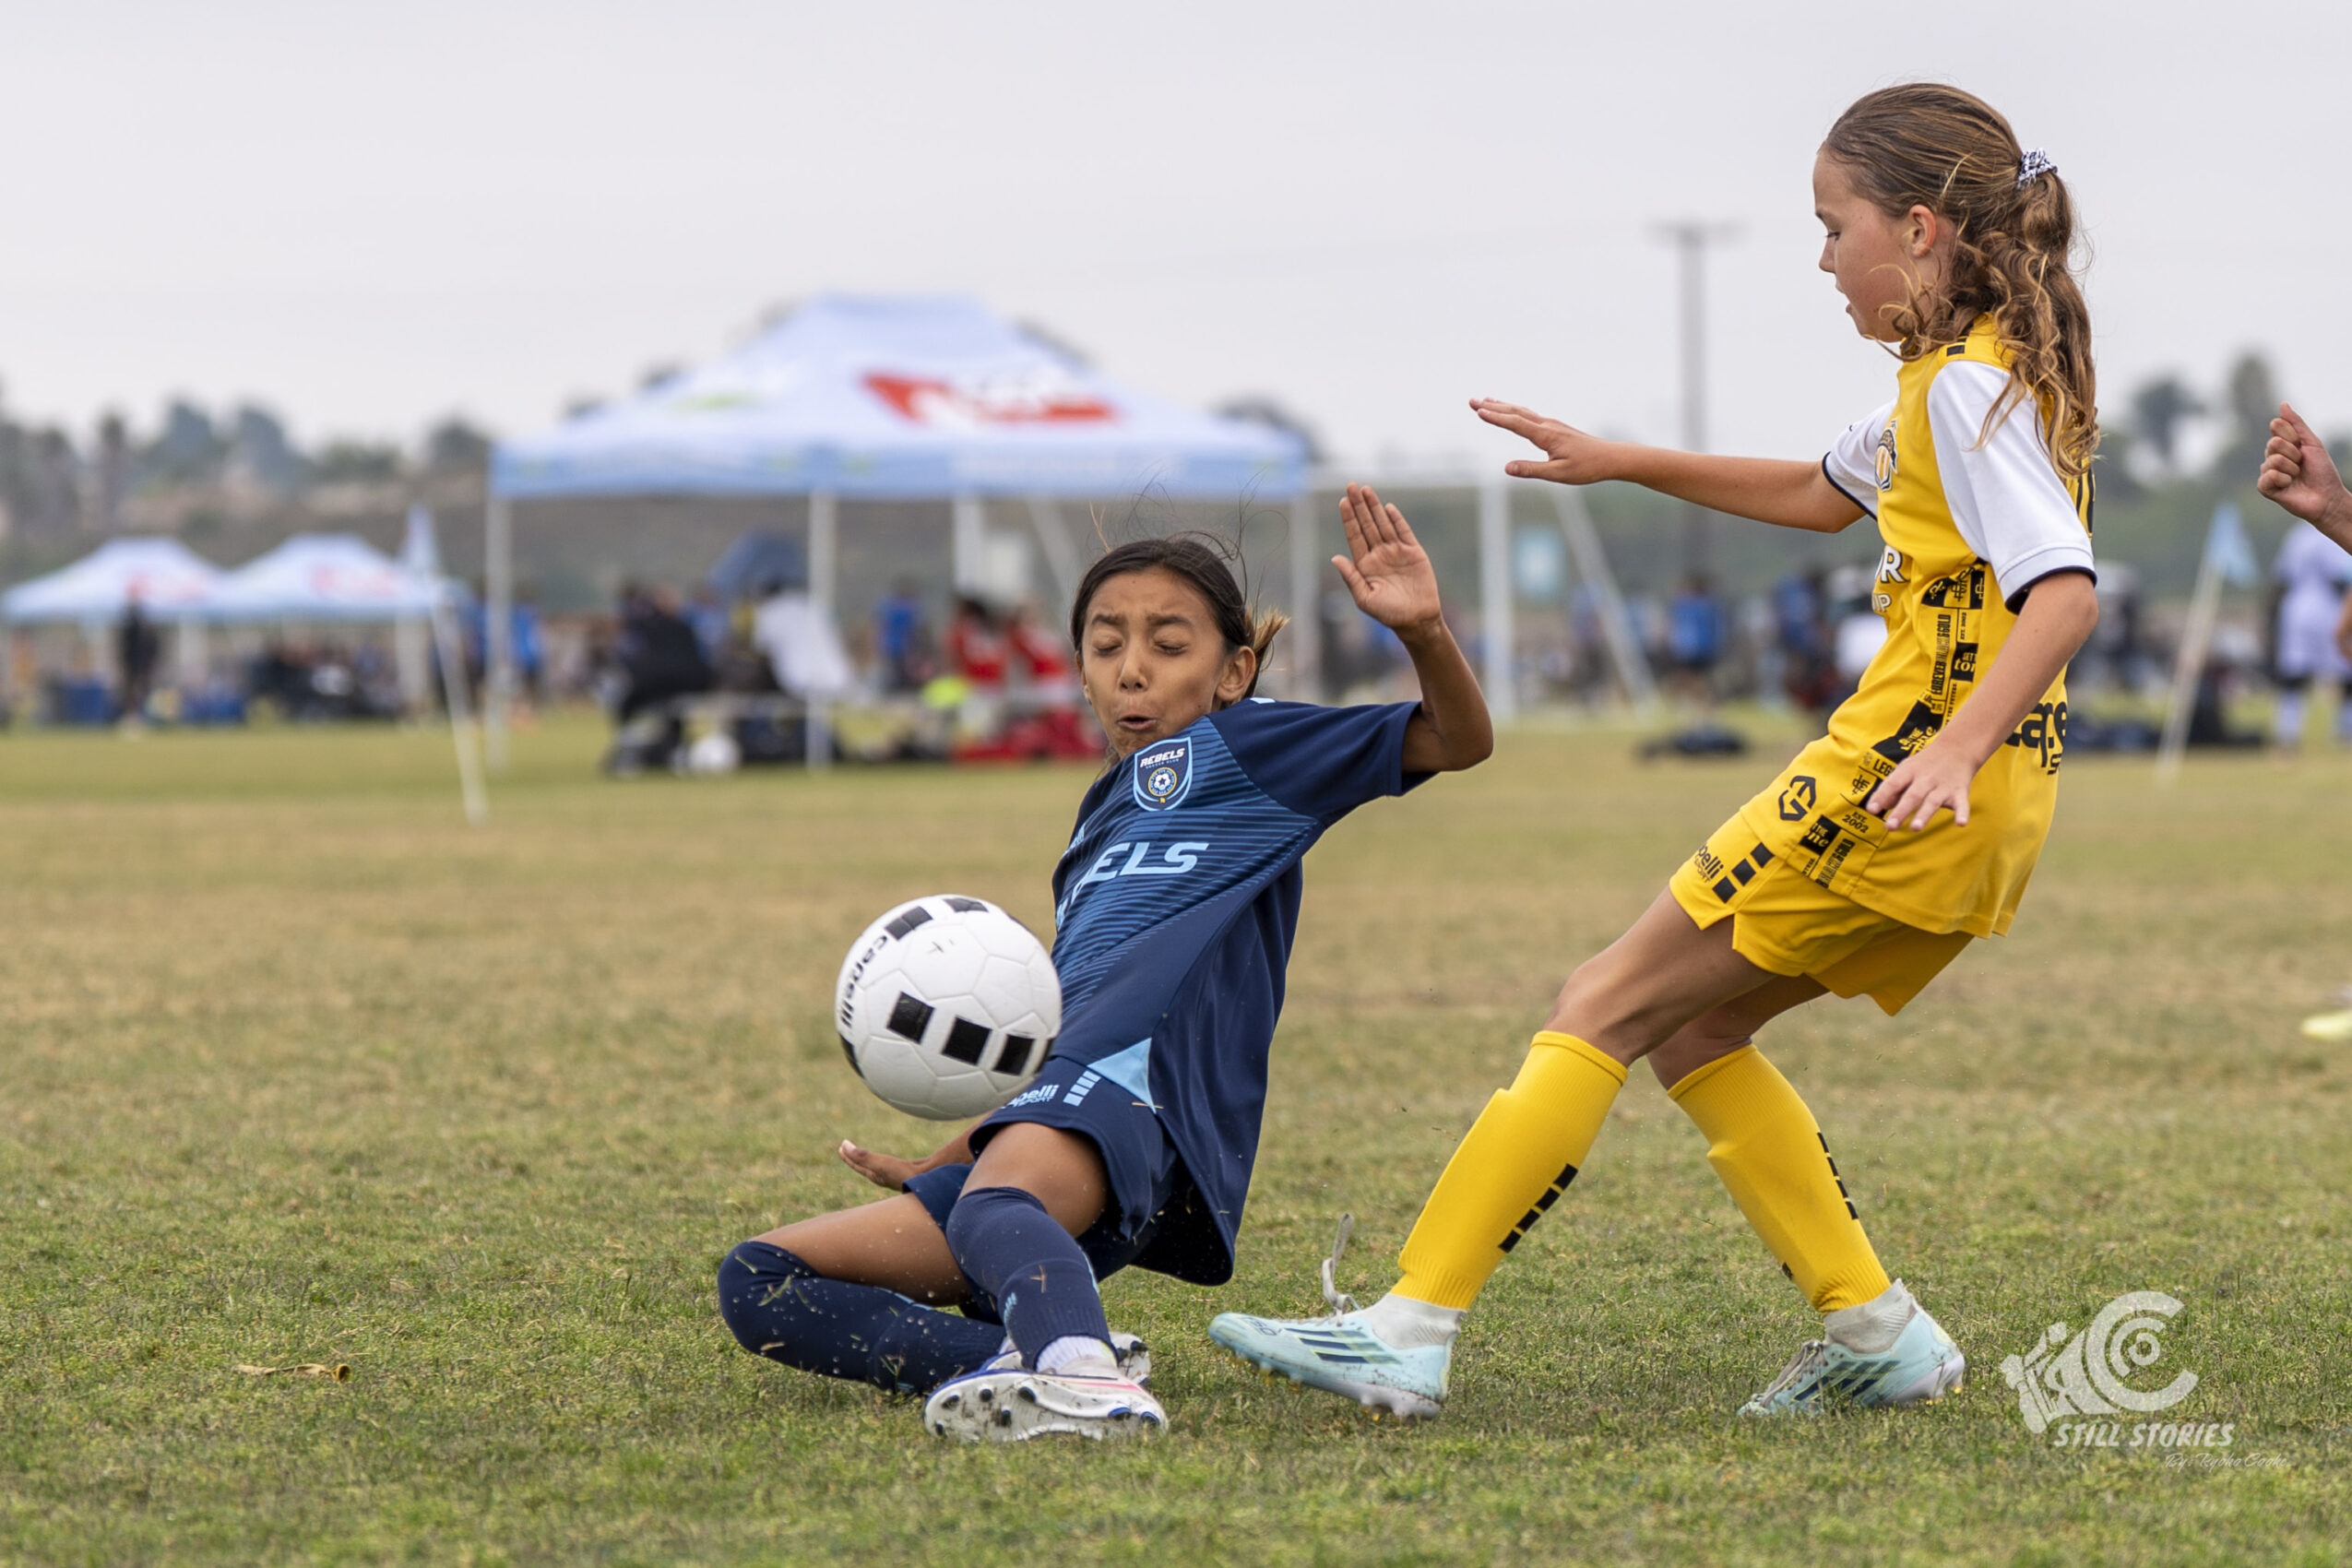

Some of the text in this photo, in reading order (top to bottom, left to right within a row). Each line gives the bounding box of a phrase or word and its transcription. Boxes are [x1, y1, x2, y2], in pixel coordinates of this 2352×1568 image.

[1140, 748, 1185, 767] REBELS
[1842, 814, 1869, 834] 2002
[840, 935, 887, 1028] capelli
